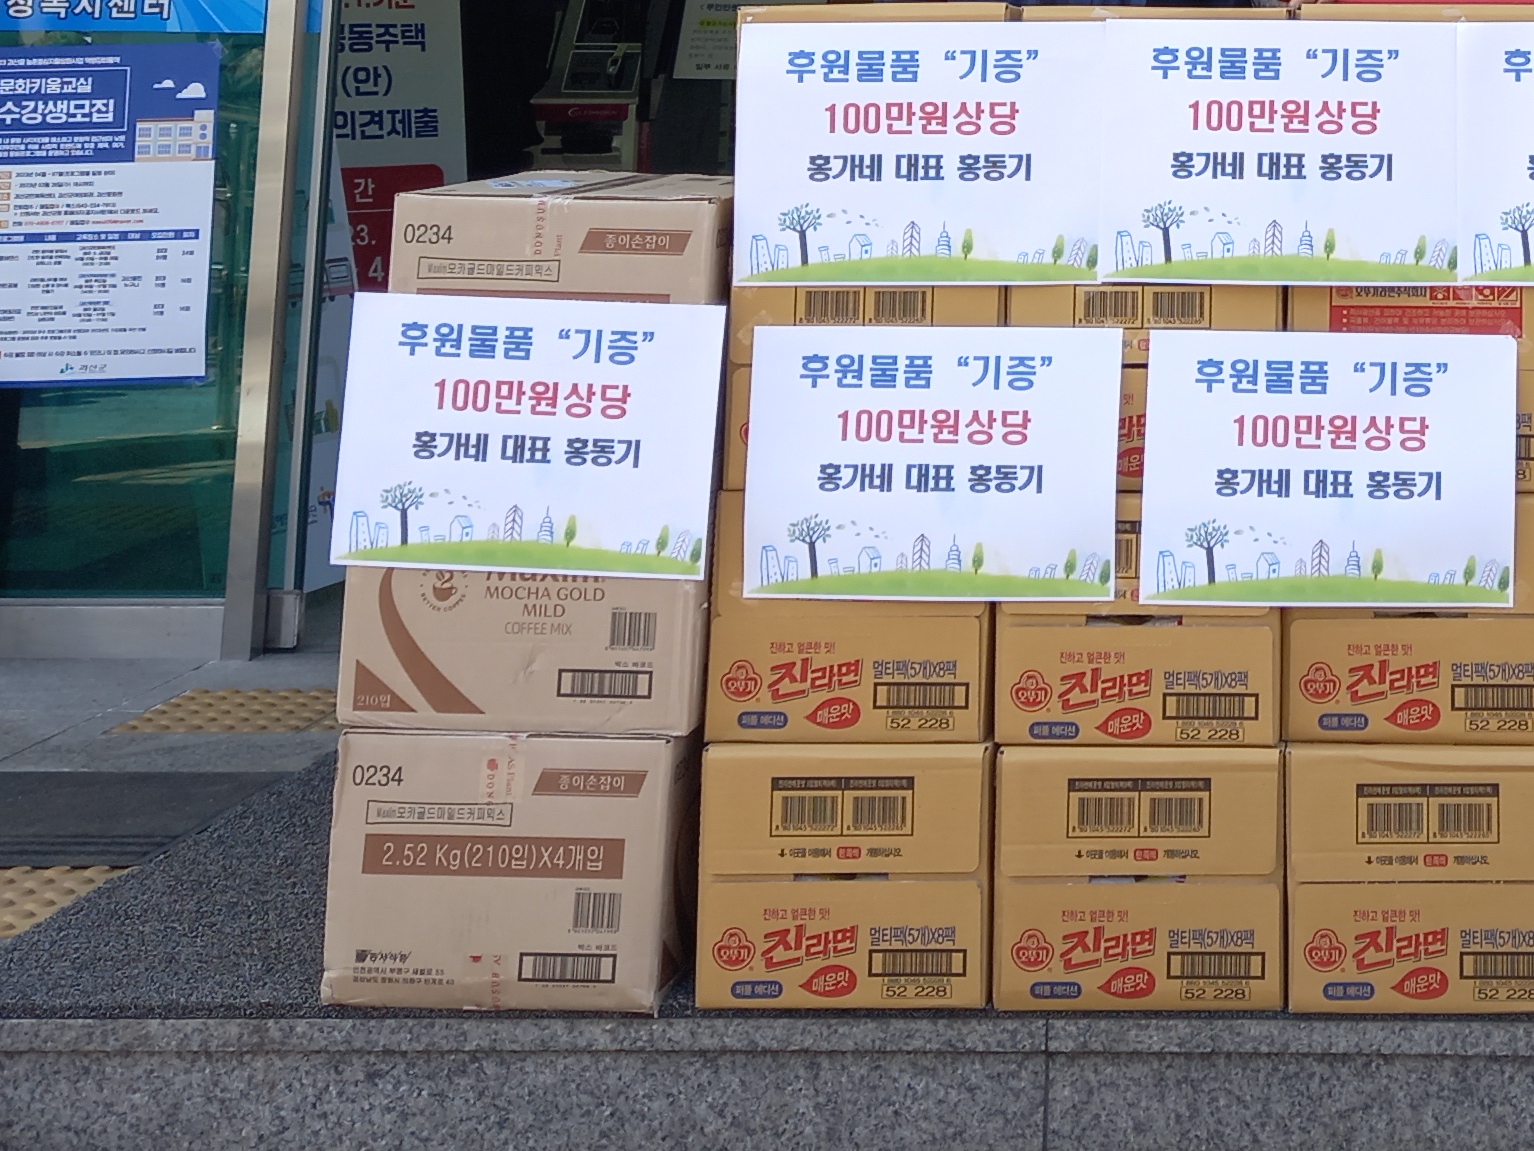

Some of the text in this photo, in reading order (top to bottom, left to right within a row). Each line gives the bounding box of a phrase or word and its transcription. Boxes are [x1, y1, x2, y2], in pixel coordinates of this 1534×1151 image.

[786, 49, 919, 83] 후원물품
[1151, 47, 1282, 80] 후원물품
[0, 77, 92, 95] 문화키움교실
[341, 64, 393, 96] (안)
[0, 99, 114, 124] 수강생모집
[334, 107, 438, 140] 의견제출
[824, 102, 1020, 136] 100만원상당
[1188, 100, 1381, 135] 100만원상당
[807, 154, 1032, 182] 홍가네 대표 홍동기
[1170, 152, 1392, 181] 홍가네 대표 홍동기
[403, 224, 454, 244] 0234
[604, 234, 670, 249] 종이손잡이
[398, 322, 533, 360] 후원물품
[800, 354, 933, 389] 후원물품
[1195, 359, 1329, 394] 후원물품
[434, 379, 631, 419] 100만원상당
[837, 409, 1031, 445] 100만원상당
[1233, 414, 1429, 451] 100만원상당
[412, 431, 641, 468] 홍가네 대표 홍동기
[817, 463, 1043, 493] 홍가네 대표 홍동기
[1214, 469, 1442, 500] 홍가네 대표 홍동기
[485, 586, 605, 601] MOCHA GOLD
[522, 604, 566, 618] MILD
[505, 622, 572, 635] COFFEE MIX
[767, 658, 864, 702] 진라면
[1057, 668, 1153, 714] 진라면
[1345, 659, 1440, 705] 진라면
[356, 694, 391, 708] 210입
[352, 764, 404, 787] 0234
[557, 774, 625, 791] 종이손잡이
[382, 842, 428, 866] 2.52
[763, 908, 788, 921] 진하고
[760, 924, 859, 972] 진라면
[1059, 926, 1158, 973] 진라면
[1352, 926, 1449, 973] 진라면
[811, 972, 850, 993] 매운맛
[885, 984, 947, 998] 52 228
